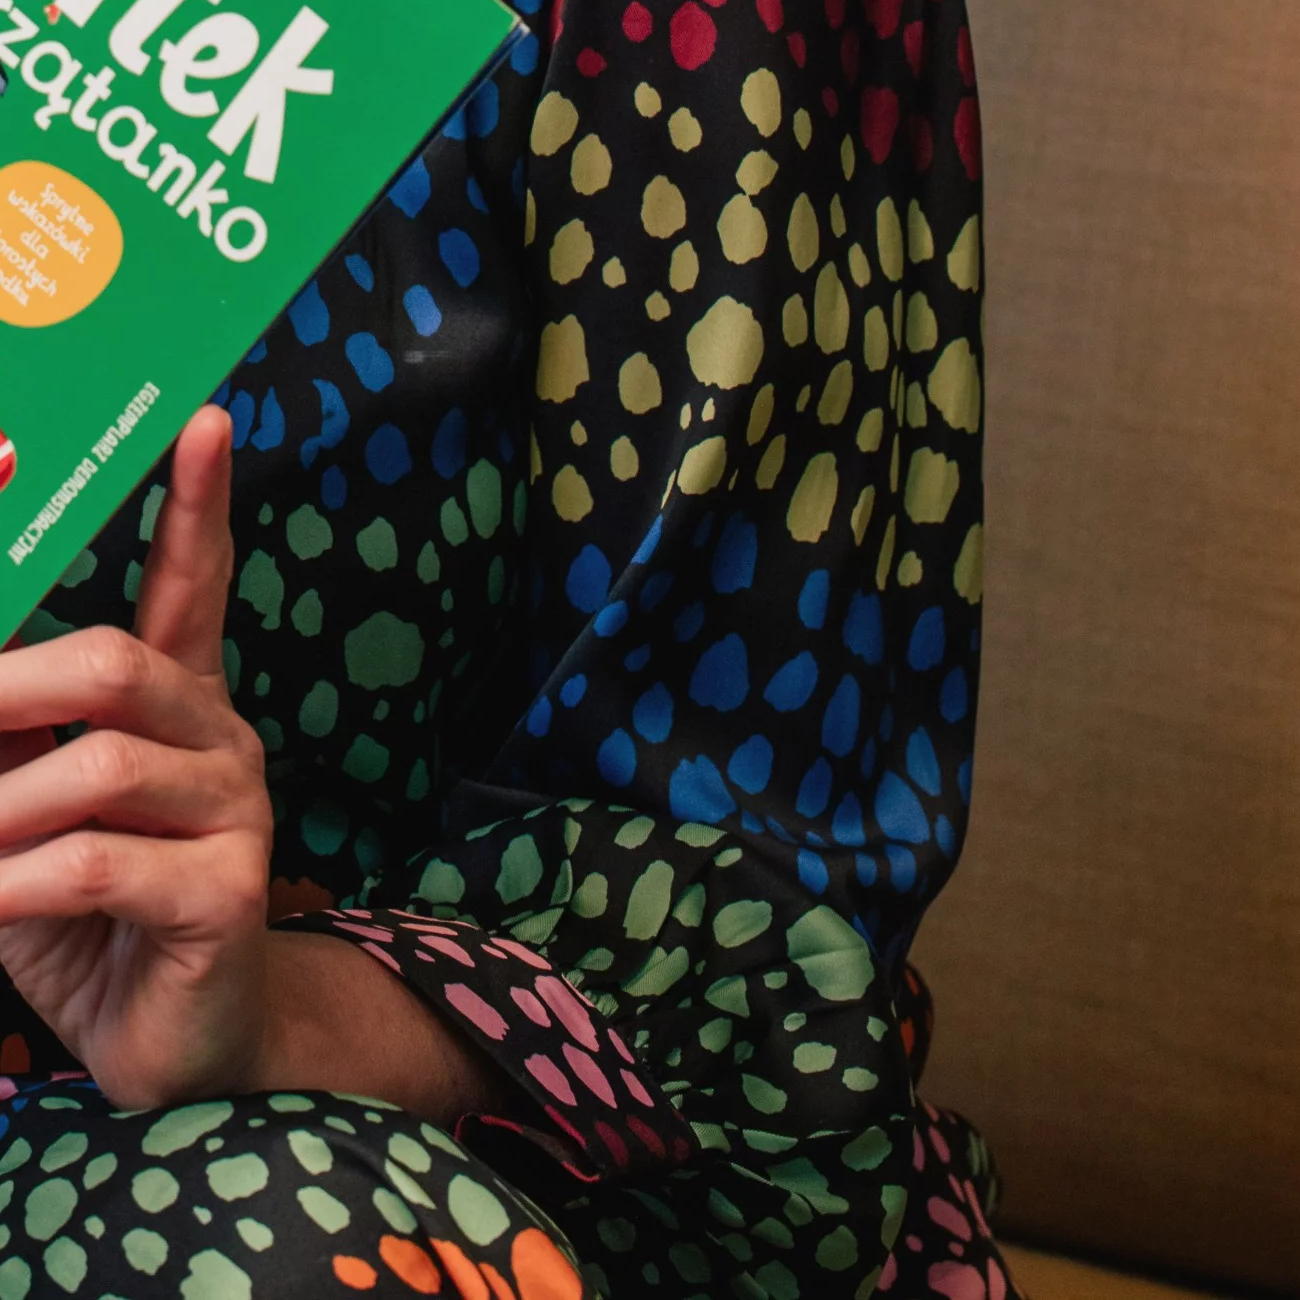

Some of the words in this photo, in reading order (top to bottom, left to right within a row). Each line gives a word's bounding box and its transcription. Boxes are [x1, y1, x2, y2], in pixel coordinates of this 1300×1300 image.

[19, 229, 50, 260] dla
[91, 380, 161, 464] EGZEMPLARZ
[7, 456, 99, 566] DEMONSTRACYJNY
